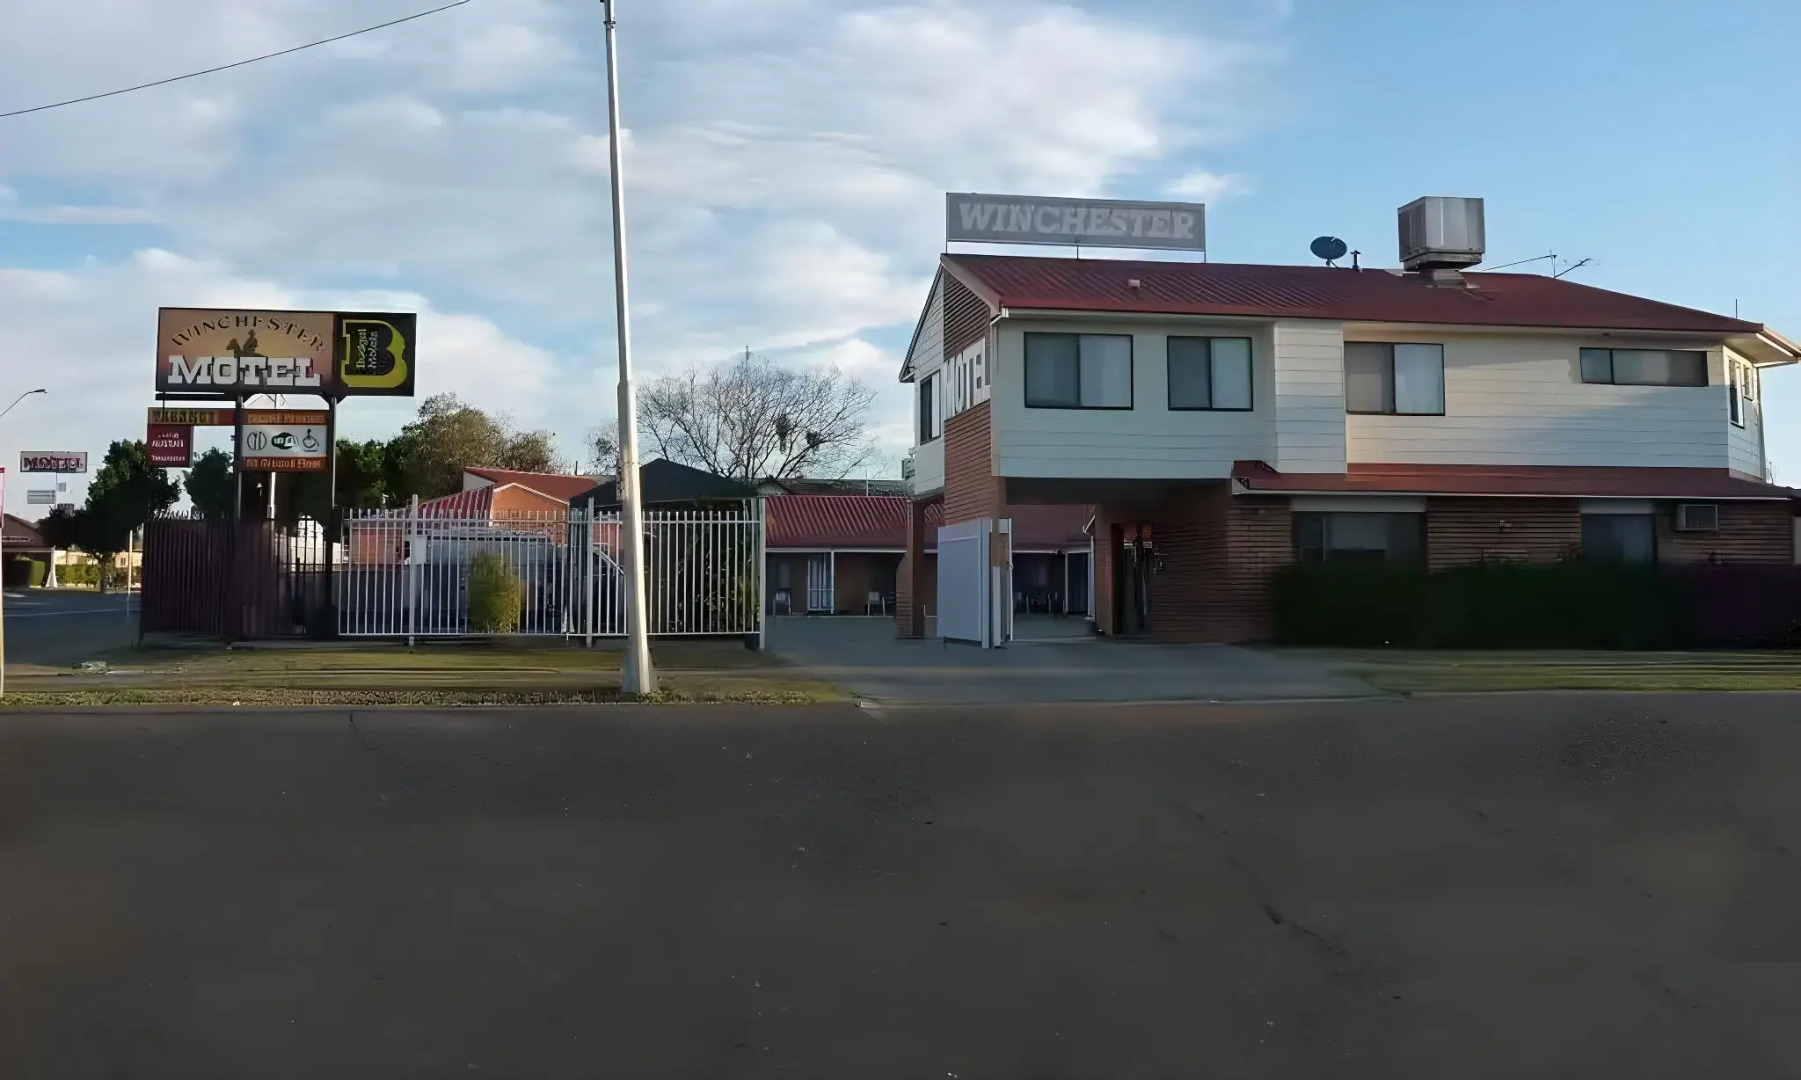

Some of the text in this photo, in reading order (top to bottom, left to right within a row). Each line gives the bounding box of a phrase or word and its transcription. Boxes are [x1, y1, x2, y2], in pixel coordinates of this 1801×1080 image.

[958, 202, 1195, 240] WINCHESTER
[171, 315, 327, 353] WINCHESTER
[167, 354, 321, 387] MOTEL
[943, 337, 991, 422] MOTEL
